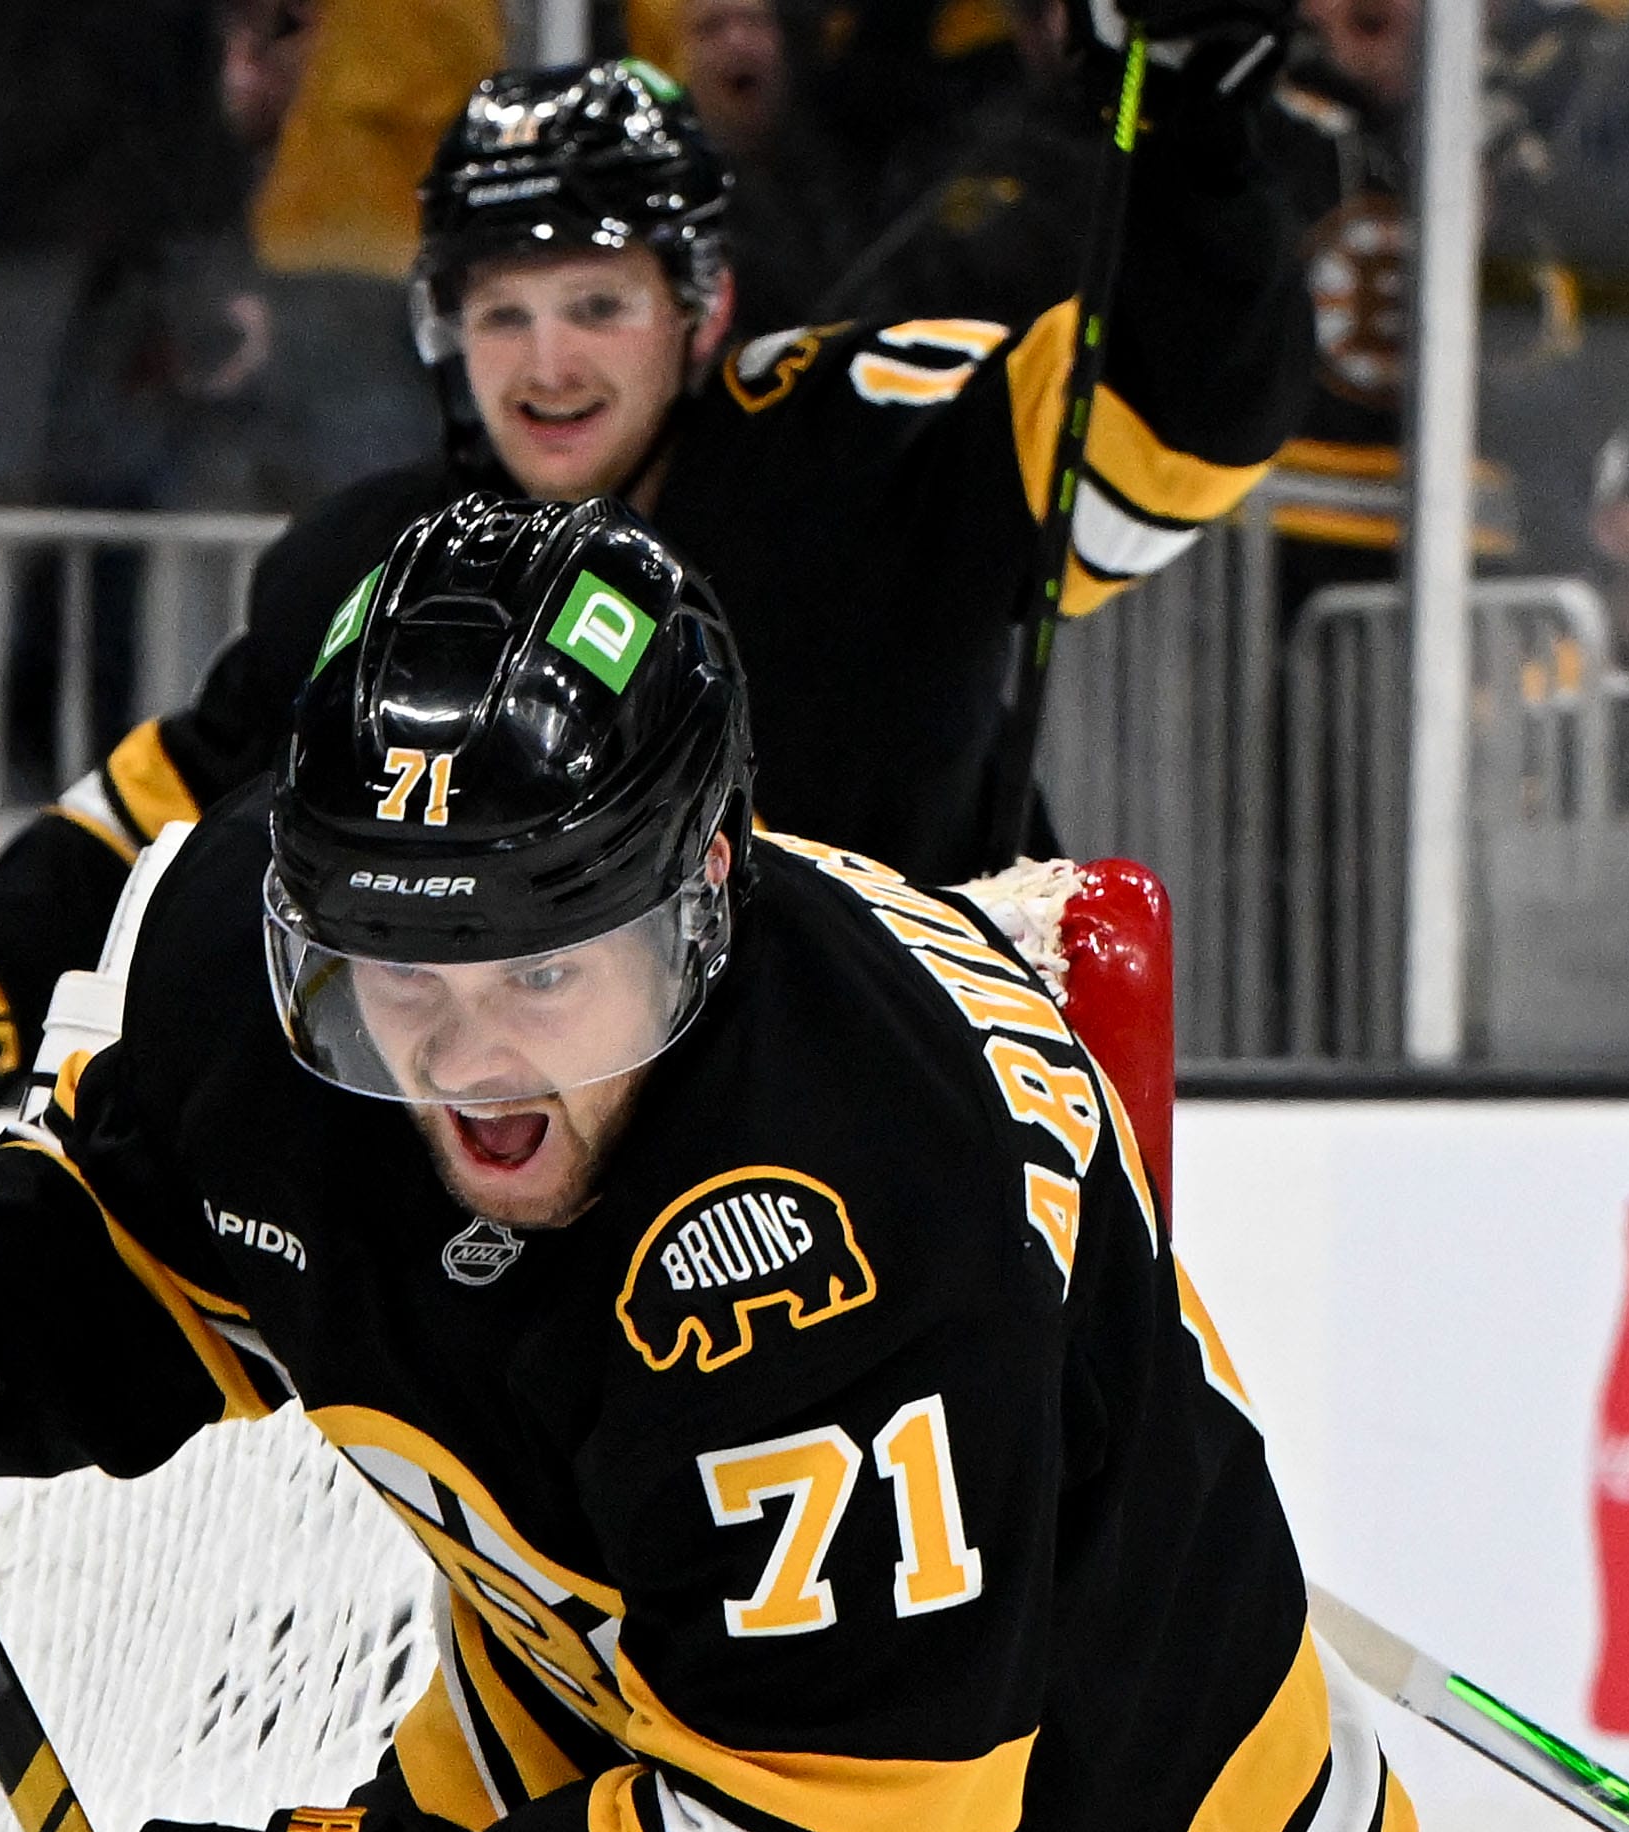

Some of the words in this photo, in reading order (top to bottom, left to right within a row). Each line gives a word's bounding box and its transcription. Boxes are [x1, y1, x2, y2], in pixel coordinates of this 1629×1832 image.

[375, 747, 453, 827] 71
[349, 870, 478, 898] BAUER
[659, 1191, 814, 1292] BRUINS
[695, 1393, 983, 1637] 71
